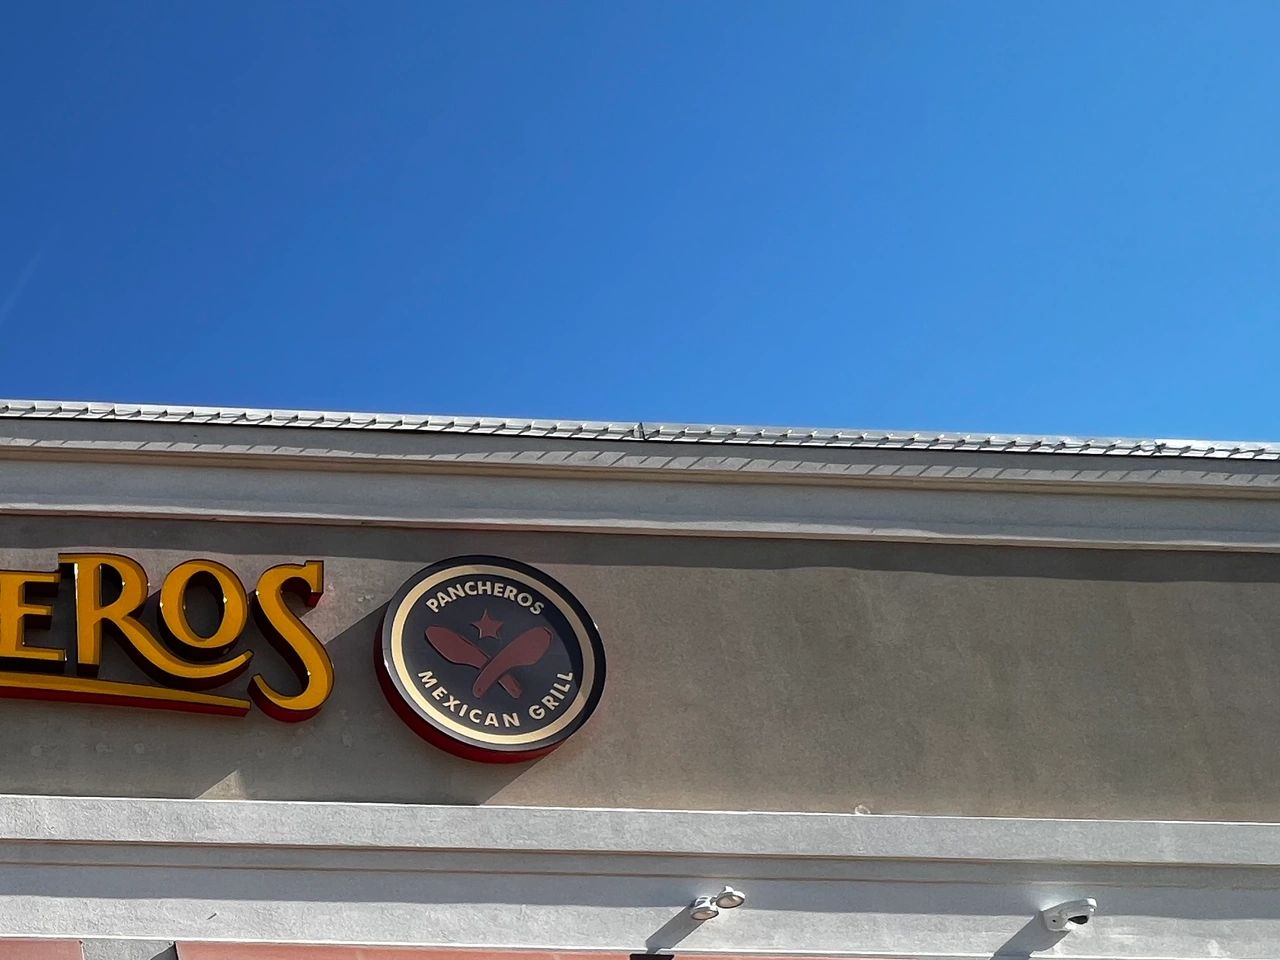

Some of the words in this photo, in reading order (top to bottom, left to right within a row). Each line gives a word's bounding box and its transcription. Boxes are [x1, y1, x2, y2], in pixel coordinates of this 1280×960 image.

[426, 581, 545, 616] PANCHEROS
[418, 670, 521, 728] MEXICAN
[528, 671, 574, 721] GRILL
